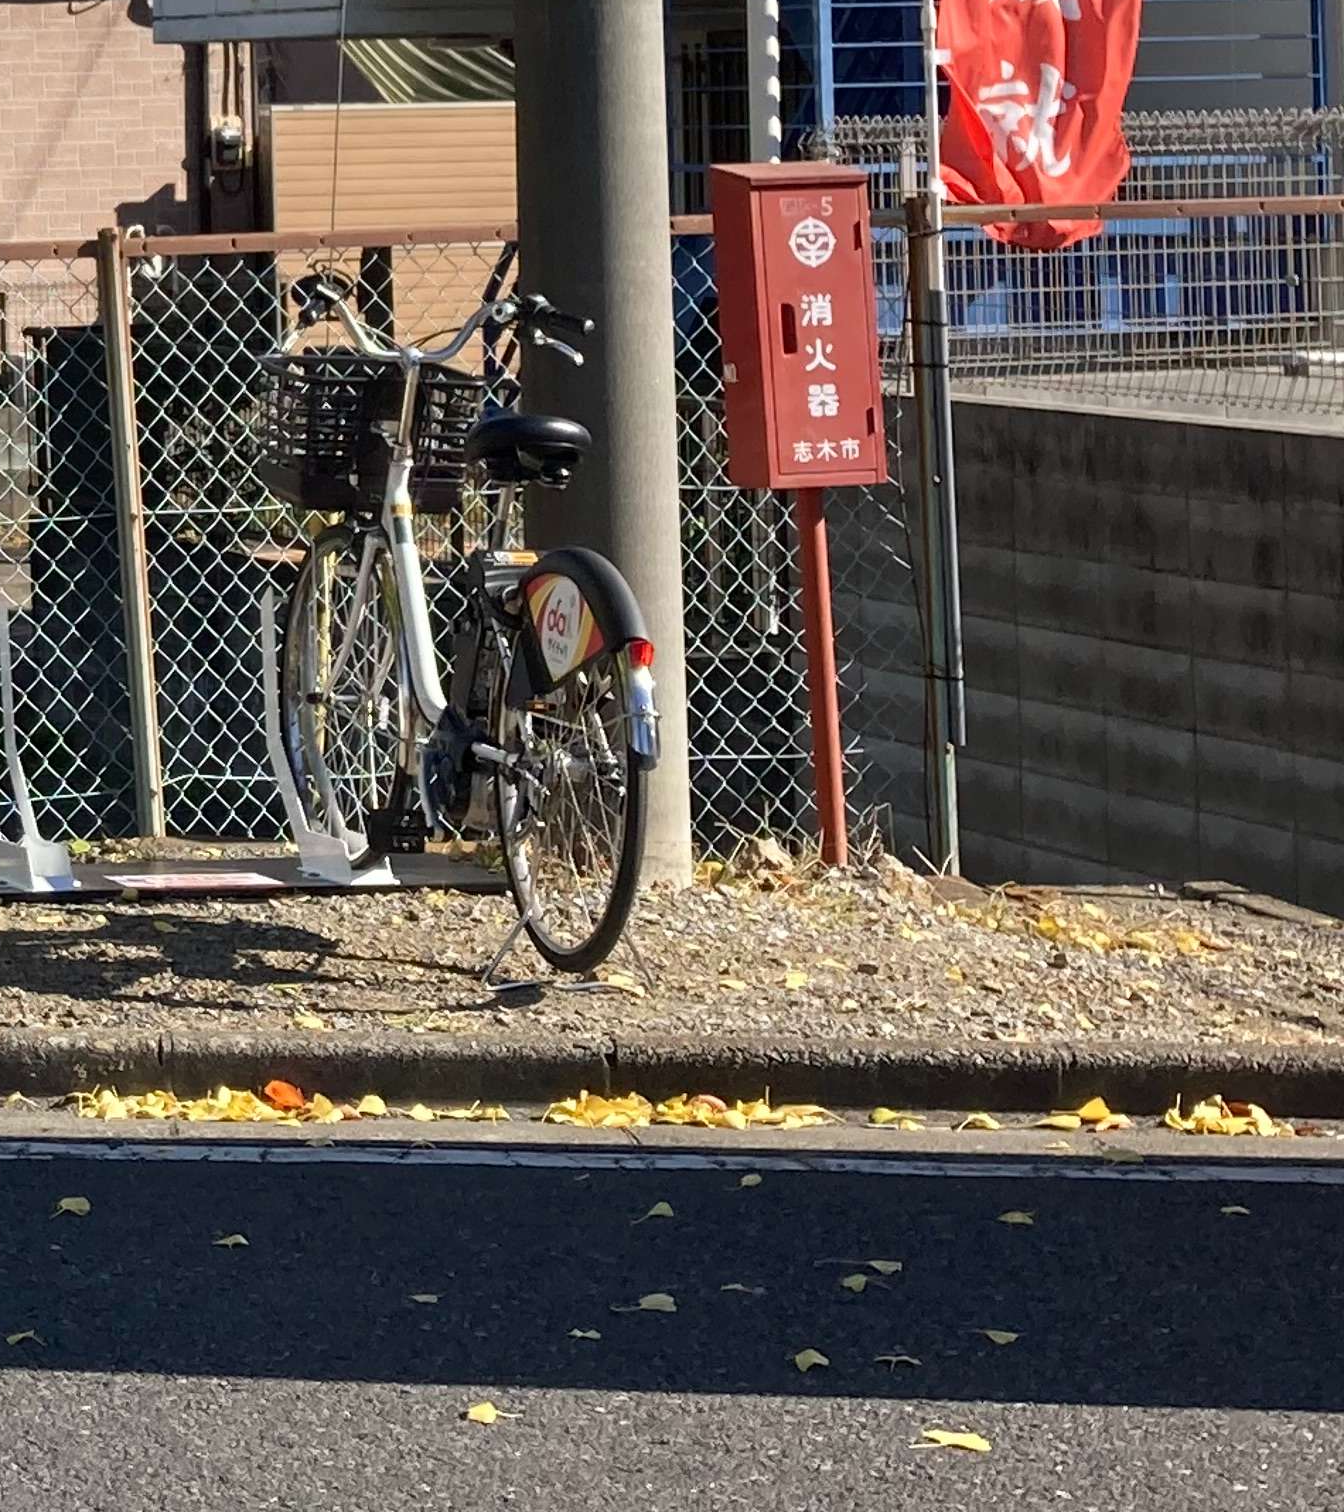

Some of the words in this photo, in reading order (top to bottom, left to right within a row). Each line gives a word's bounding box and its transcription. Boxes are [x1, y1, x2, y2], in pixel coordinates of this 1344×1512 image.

[821, 196, 833, 216] 5
[800, 294, 840, 418] 消火器
[792, 438, 860, 464] 志木市
